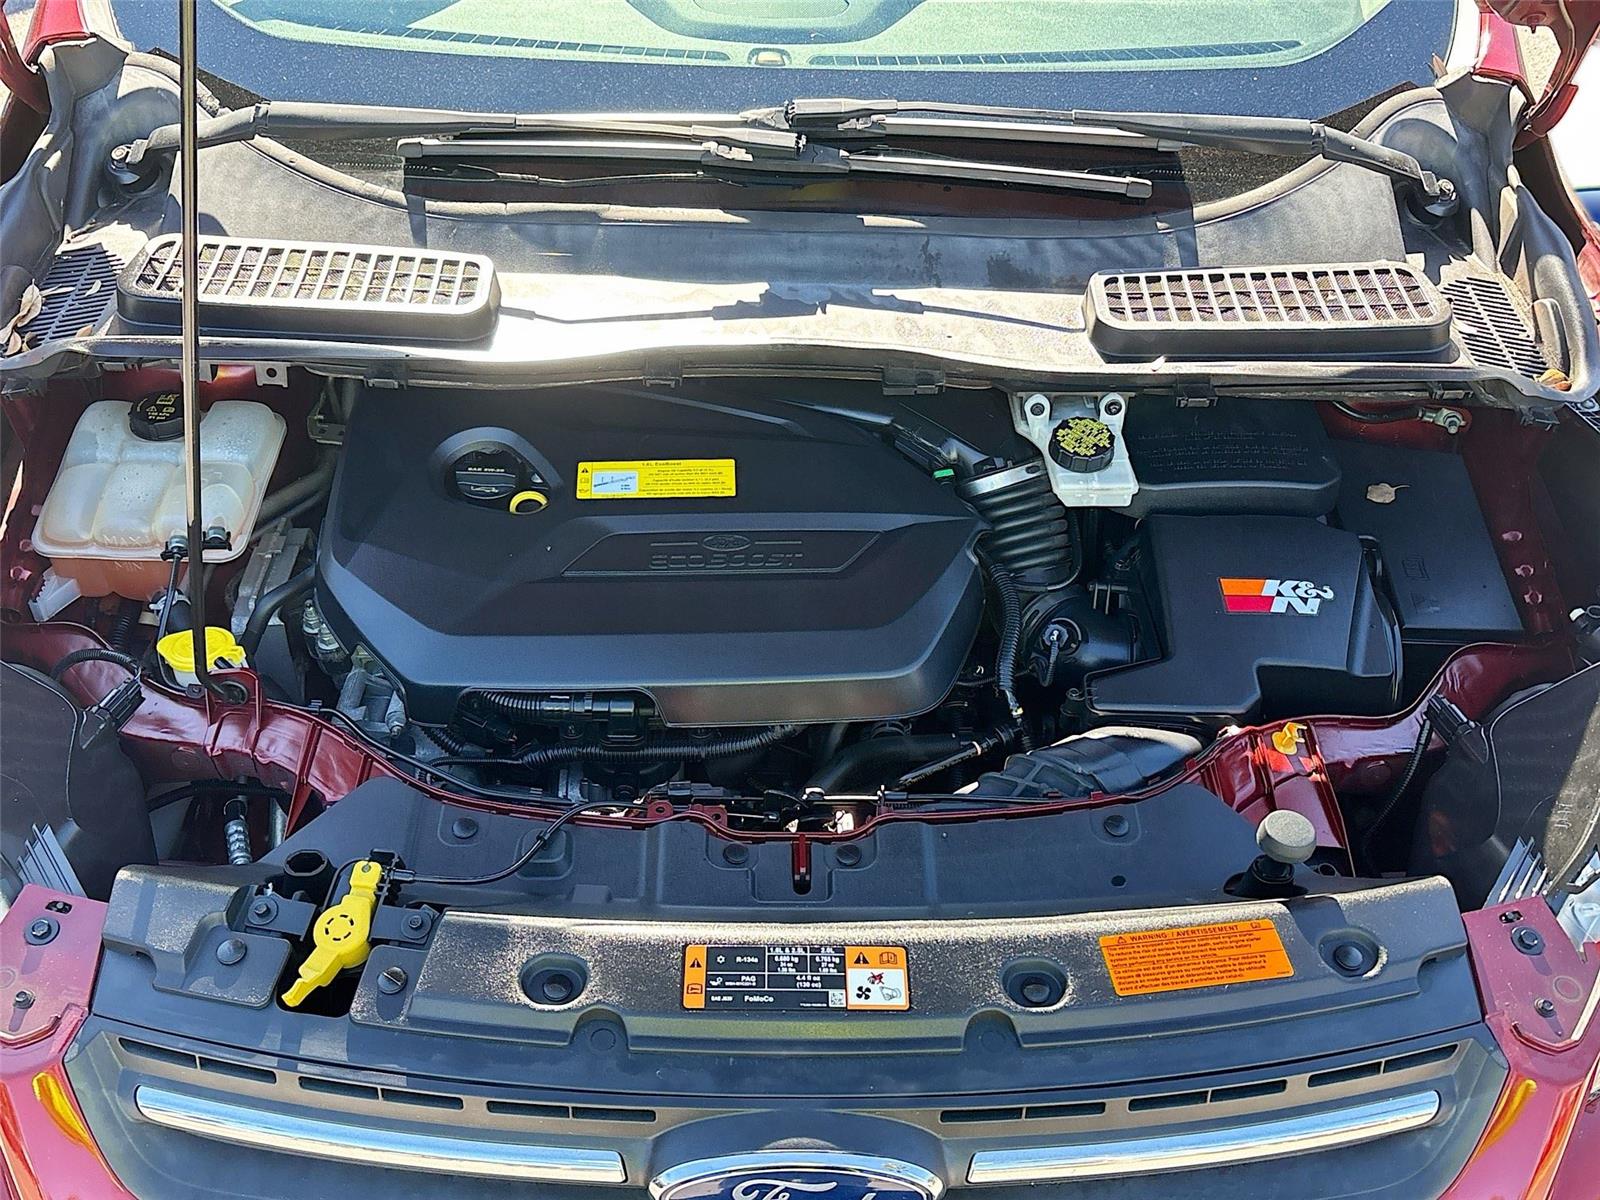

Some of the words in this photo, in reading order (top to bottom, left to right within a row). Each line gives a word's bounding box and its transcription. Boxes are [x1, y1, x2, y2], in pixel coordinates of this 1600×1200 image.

[103, 534, 143, 547] MAX
[1130, 932, 1167, 942] WARNING
[1177, 924, 1238, 937] AVERTISSEMENT
